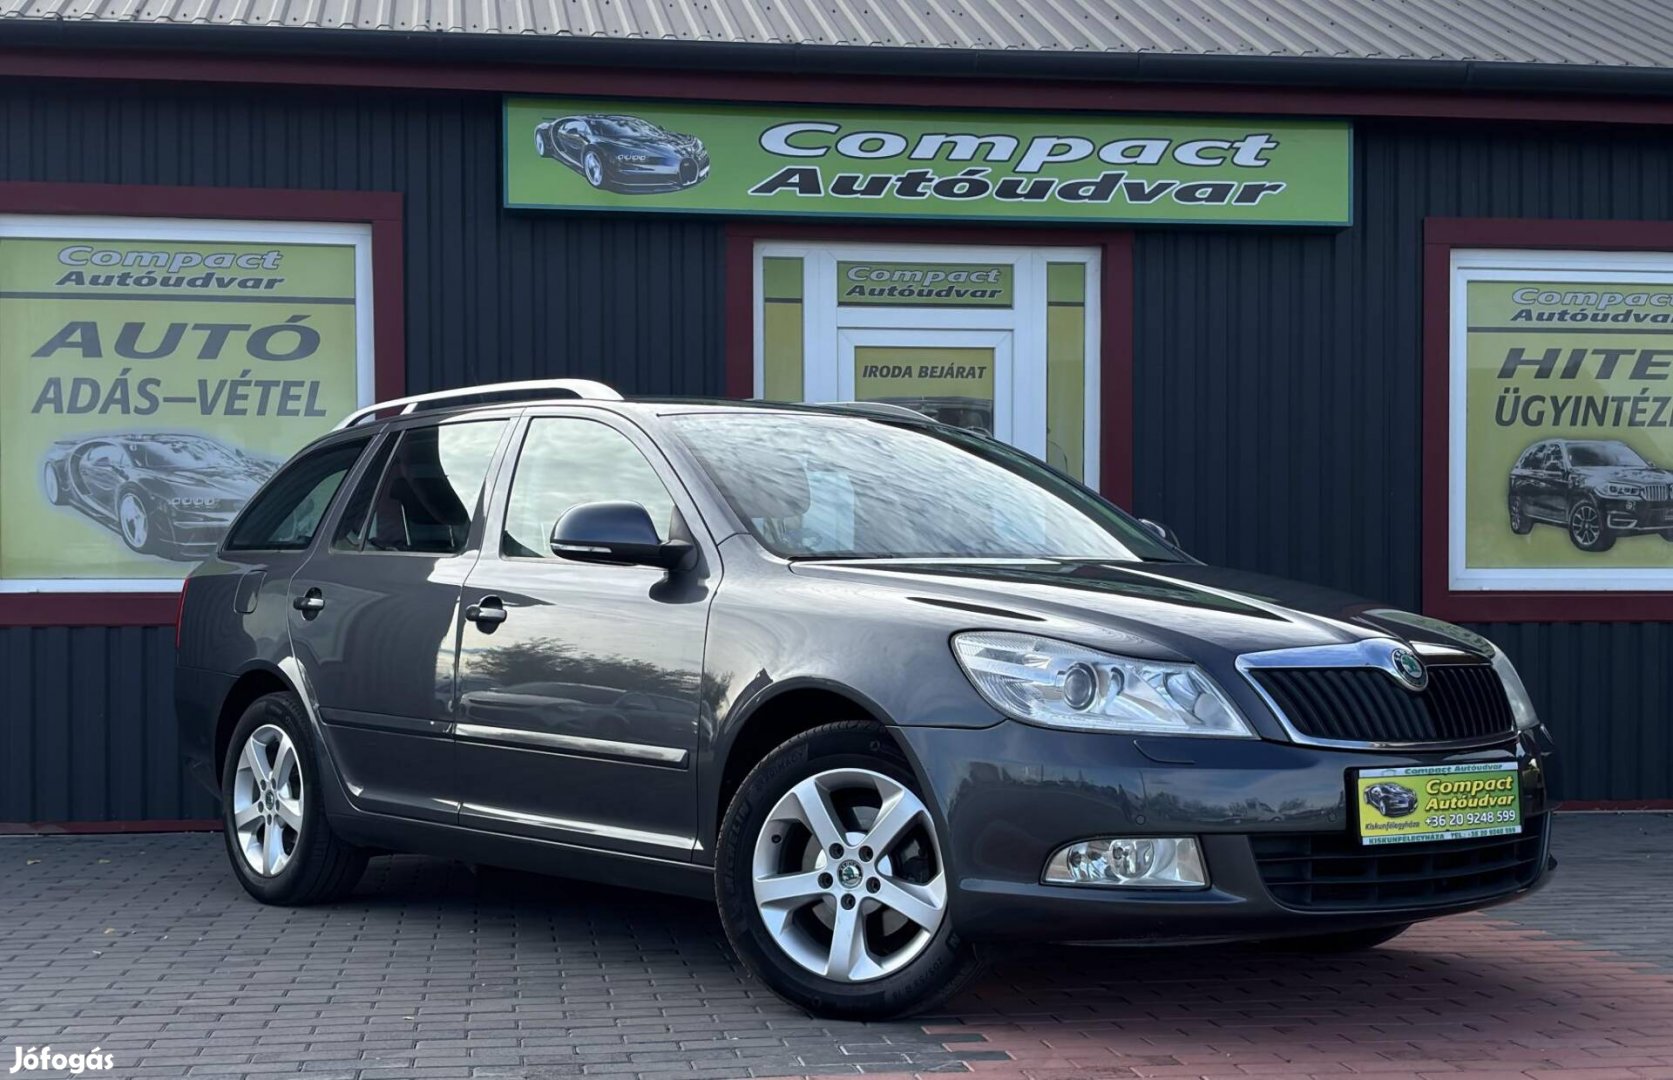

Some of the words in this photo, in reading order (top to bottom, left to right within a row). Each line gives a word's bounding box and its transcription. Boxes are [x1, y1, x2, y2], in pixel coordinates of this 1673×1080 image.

[759, 121, 1279, 173] Compact
[748, 165, 1286, 206] Autóudvar
[57, 246, 284, 273] Compact
[55, 270, 284, 290] Autóudvar
[847, 265, 1001, 287] Compact
[846, 284, 1003, 299] Autóudvar
[1512, 287, 1673, 310] Compac
[1509, 308, 1673, 323] Autóudva
[30, 314, 321, 361] AUTÓ
[862, 364, 913, 379] IRODA
[917, 362, 987, 380] BEJÁRAT
[1404, 766, 1451, 775] Compact
[1454, 764, 1503, 772] Autóudvar
[1425, 776, 1513, 796] Compact
[1425, 793, 1515, 811] Autóudvar
[1425, 814, 1446, 828] +36
[1449, 813, 1464, 825] 20
[1466, 811, 1494, 824] 9248
[1497, 809, 1516, 822] 599
